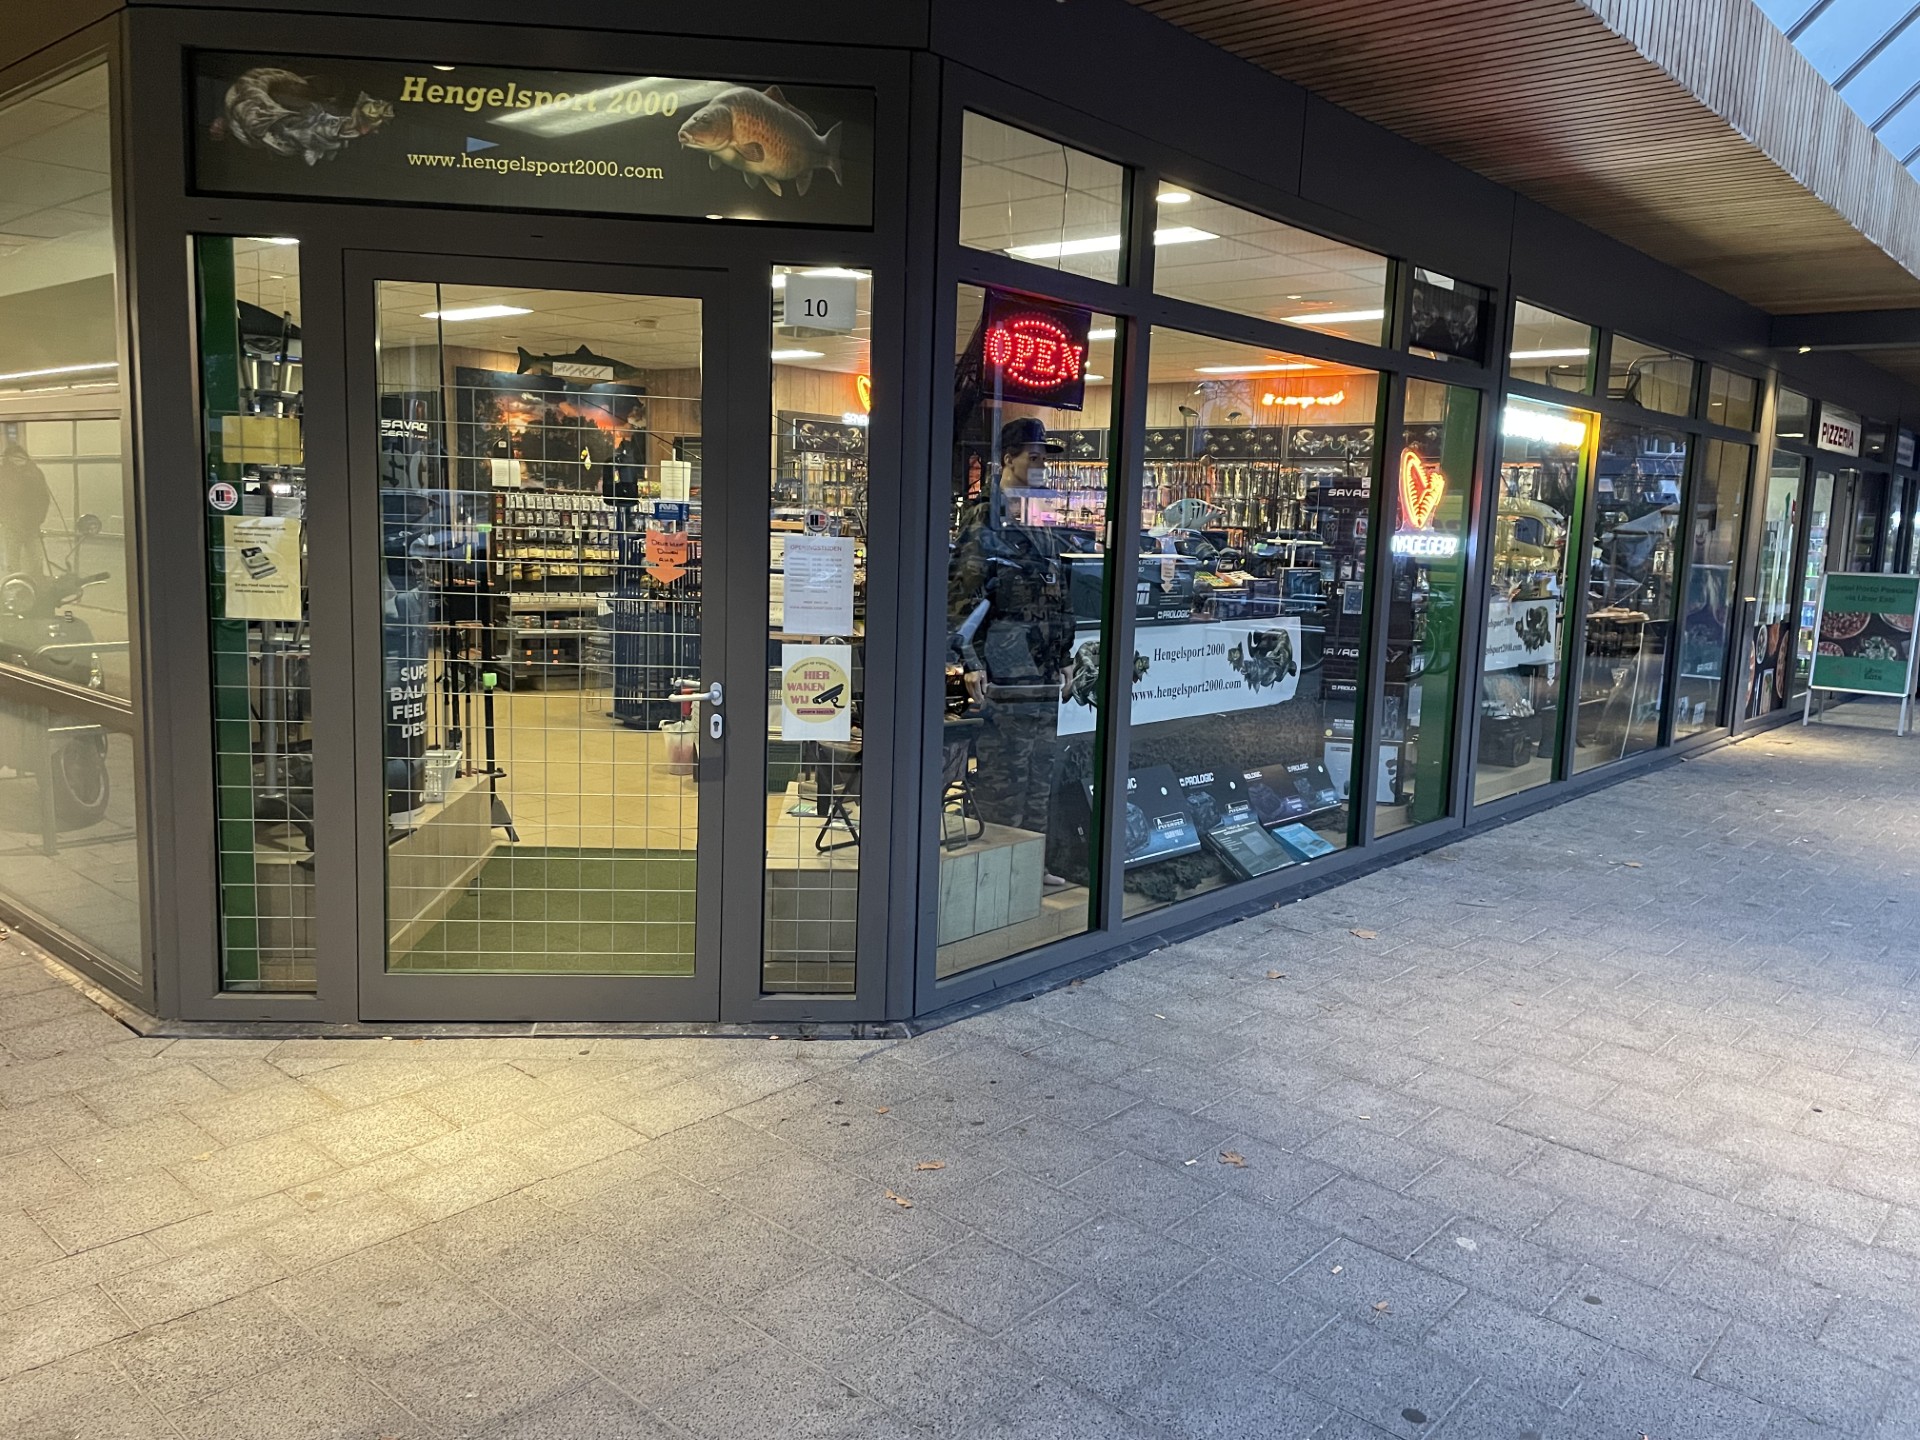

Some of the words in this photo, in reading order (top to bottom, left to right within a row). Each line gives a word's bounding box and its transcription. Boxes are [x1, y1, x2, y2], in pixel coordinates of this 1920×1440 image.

[400, 76, 600, 117] Hengelsport
[604, 89, 679, 118] 2000
[407, 152, 664, 181] www.hengelsport2000.com
[803, 298, 828, 318] 10
[989, 329, 1083, 381] OPEN
[1821, 422, 1854, 450] PIZZERIA
[1328, 488, 1371, 499] SAVAG
[1153, 646, 1205, 663] Hengelsport
[1206, 643, 1226, 657] 2000
[400, 663, 428, 682] SUPE
[804, 671, 830, 680] HIER
[786, 682, 826, 692] WAKEN
[1131, 679, 1241, 702] www.hengelsport2000.com
[790, 695, 809, 704] WIJ
[401, 720, 427, 739] DES
[1184, 771, 1215, 787] PROLOGIC
